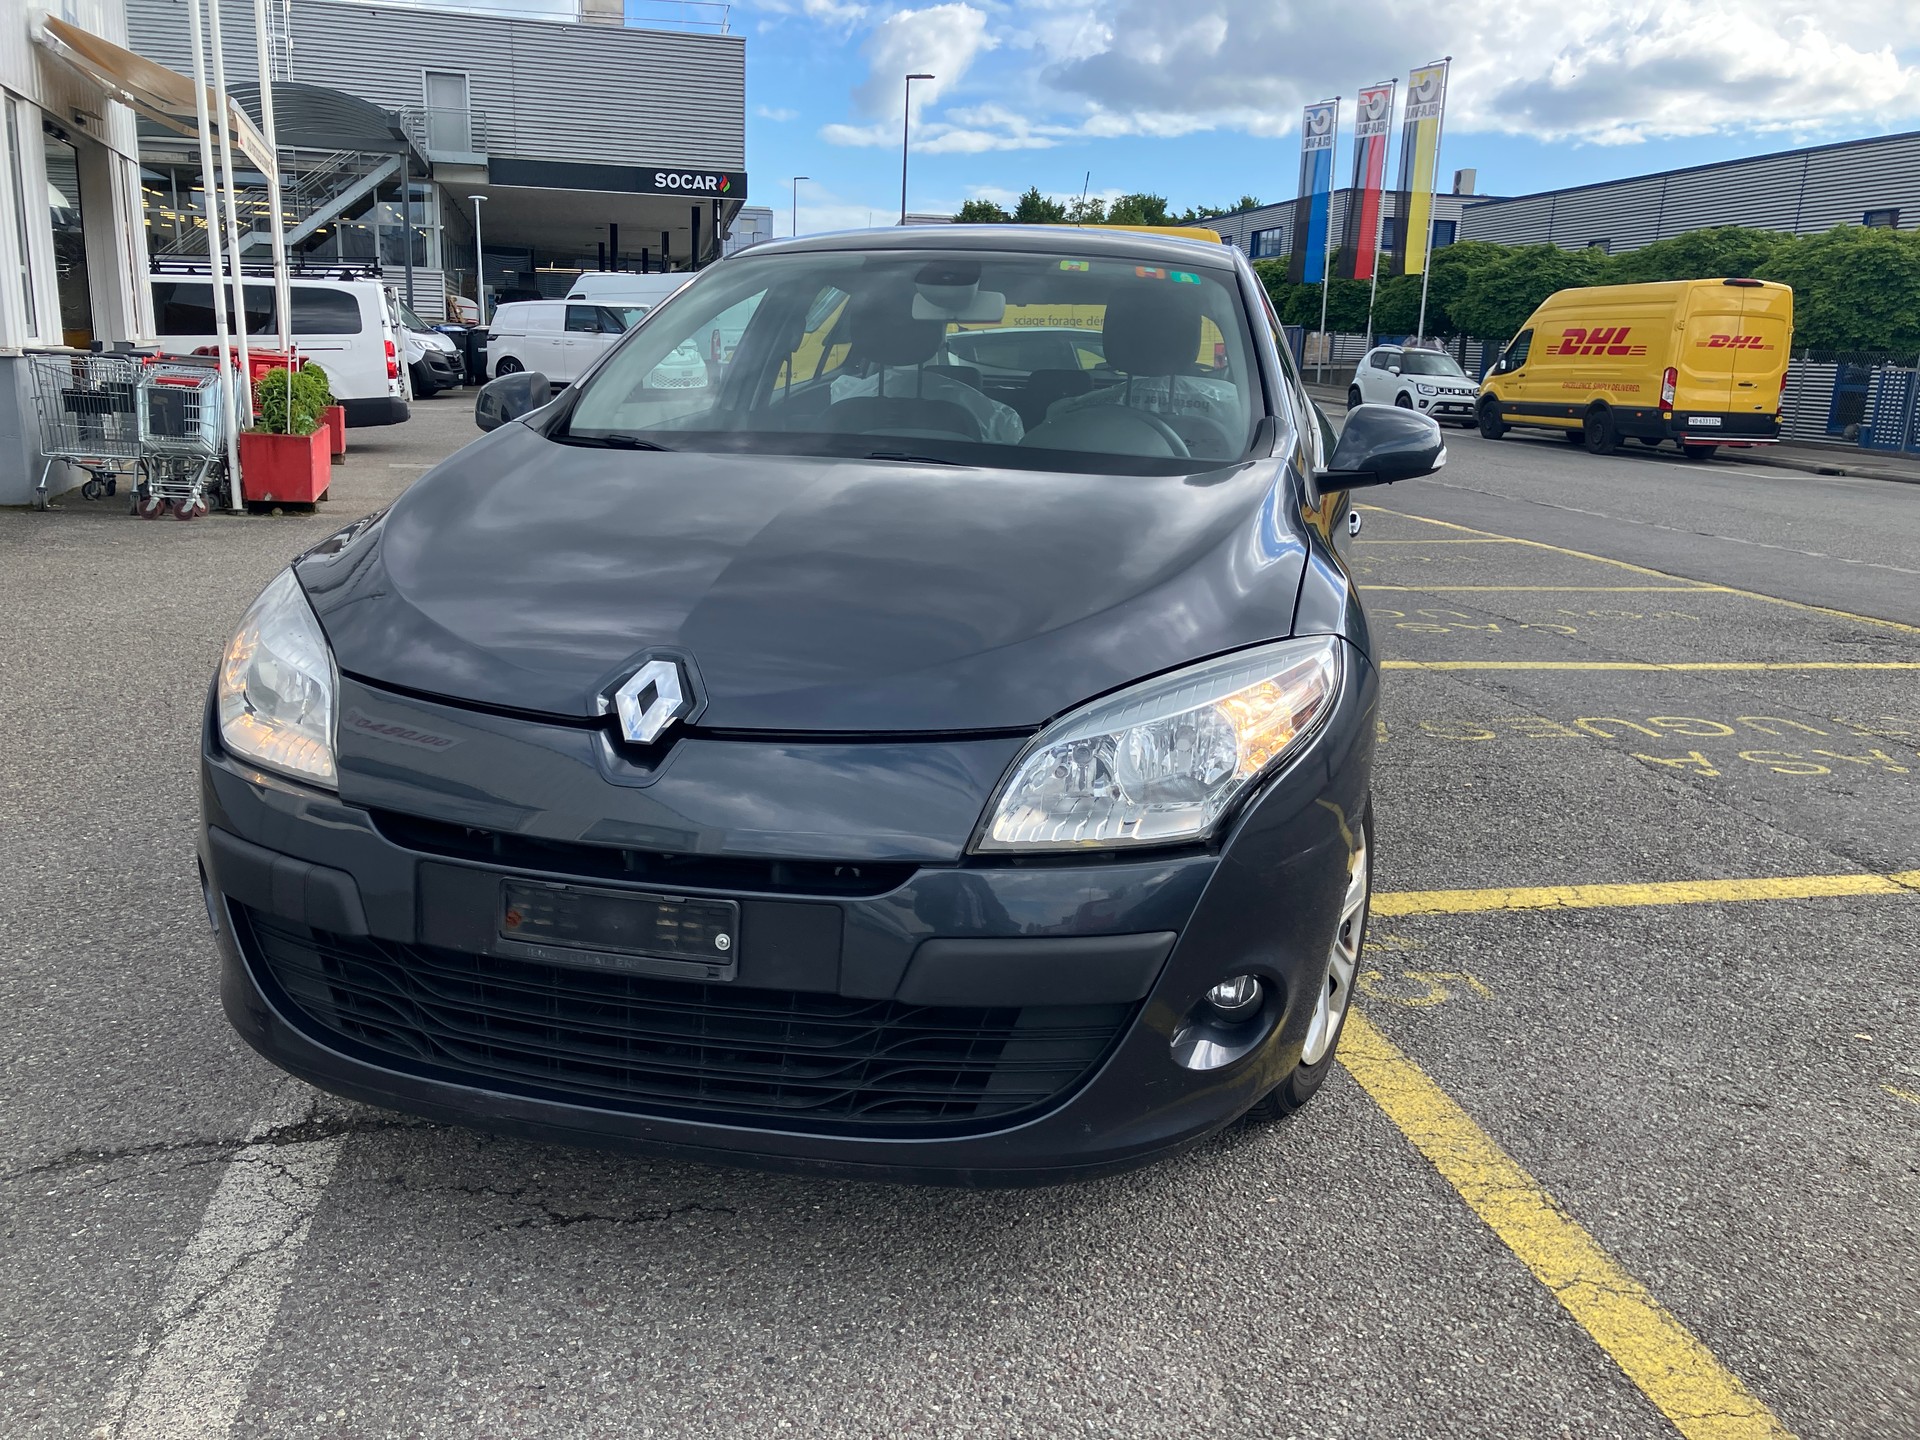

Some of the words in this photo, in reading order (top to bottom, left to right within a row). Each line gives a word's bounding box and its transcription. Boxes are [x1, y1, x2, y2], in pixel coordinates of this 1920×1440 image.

[654, 172, 717, 190] SOCAR
[1013, 316, 1045, 327] sciage
[1048, 315, 1083, 327] forage
[1558, 327, 1631, 355] DHL
[1707, 334, 1764, 350] DHL
[1593, 382, 1611, 391] SIMPLY
[1611, 383, 1640, 393] DELIVERED.
